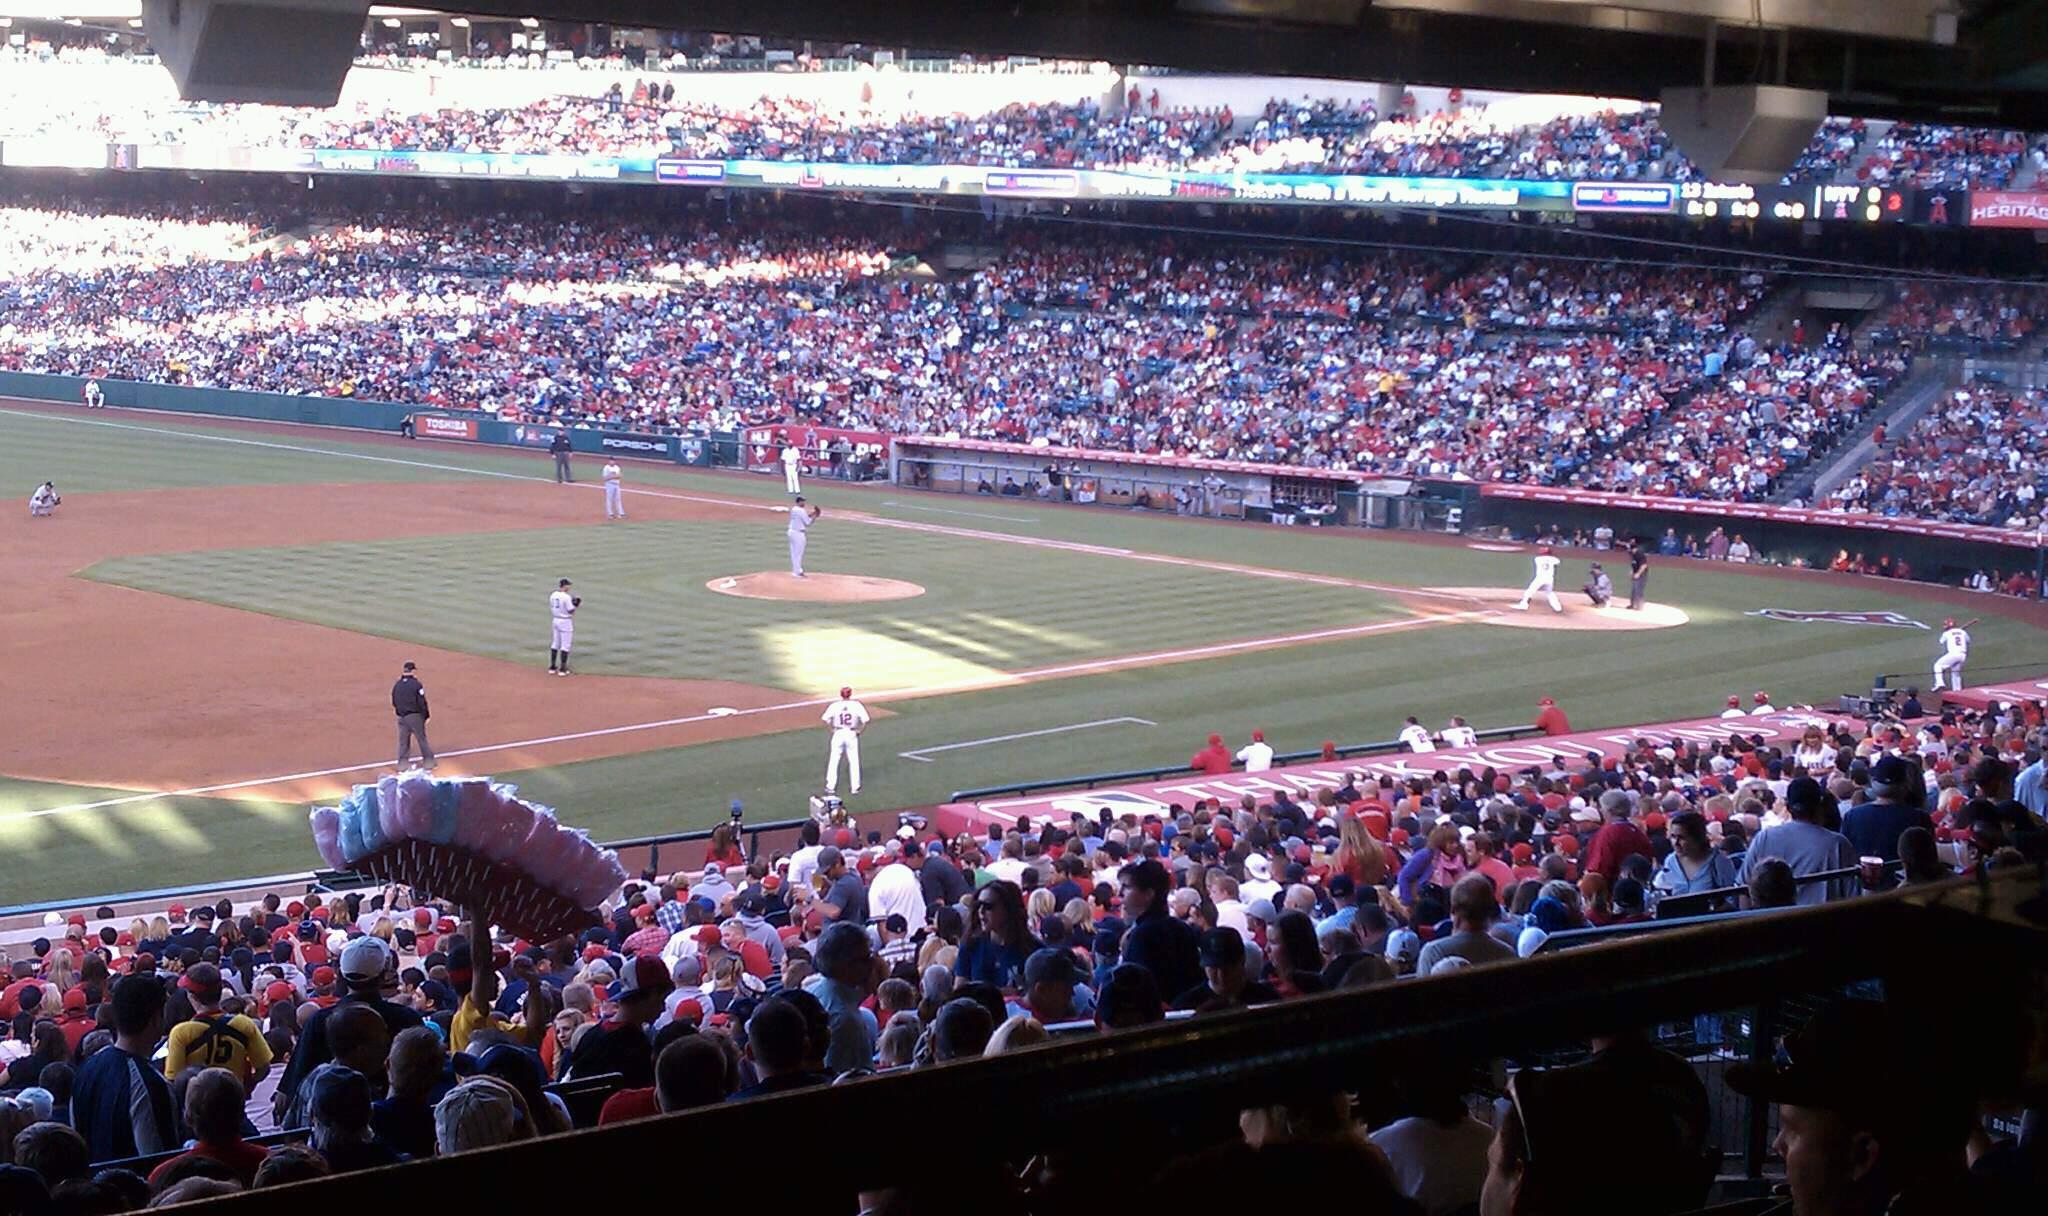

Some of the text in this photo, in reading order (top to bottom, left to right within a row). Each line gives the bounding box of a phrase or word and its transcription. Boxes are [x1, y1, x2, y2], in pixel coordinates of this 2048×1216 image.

[425, 418, 467, 431] TOSHIBA
[603, 438, 668, 452] PORSCHE
[839, 713, 852, 726] 12
